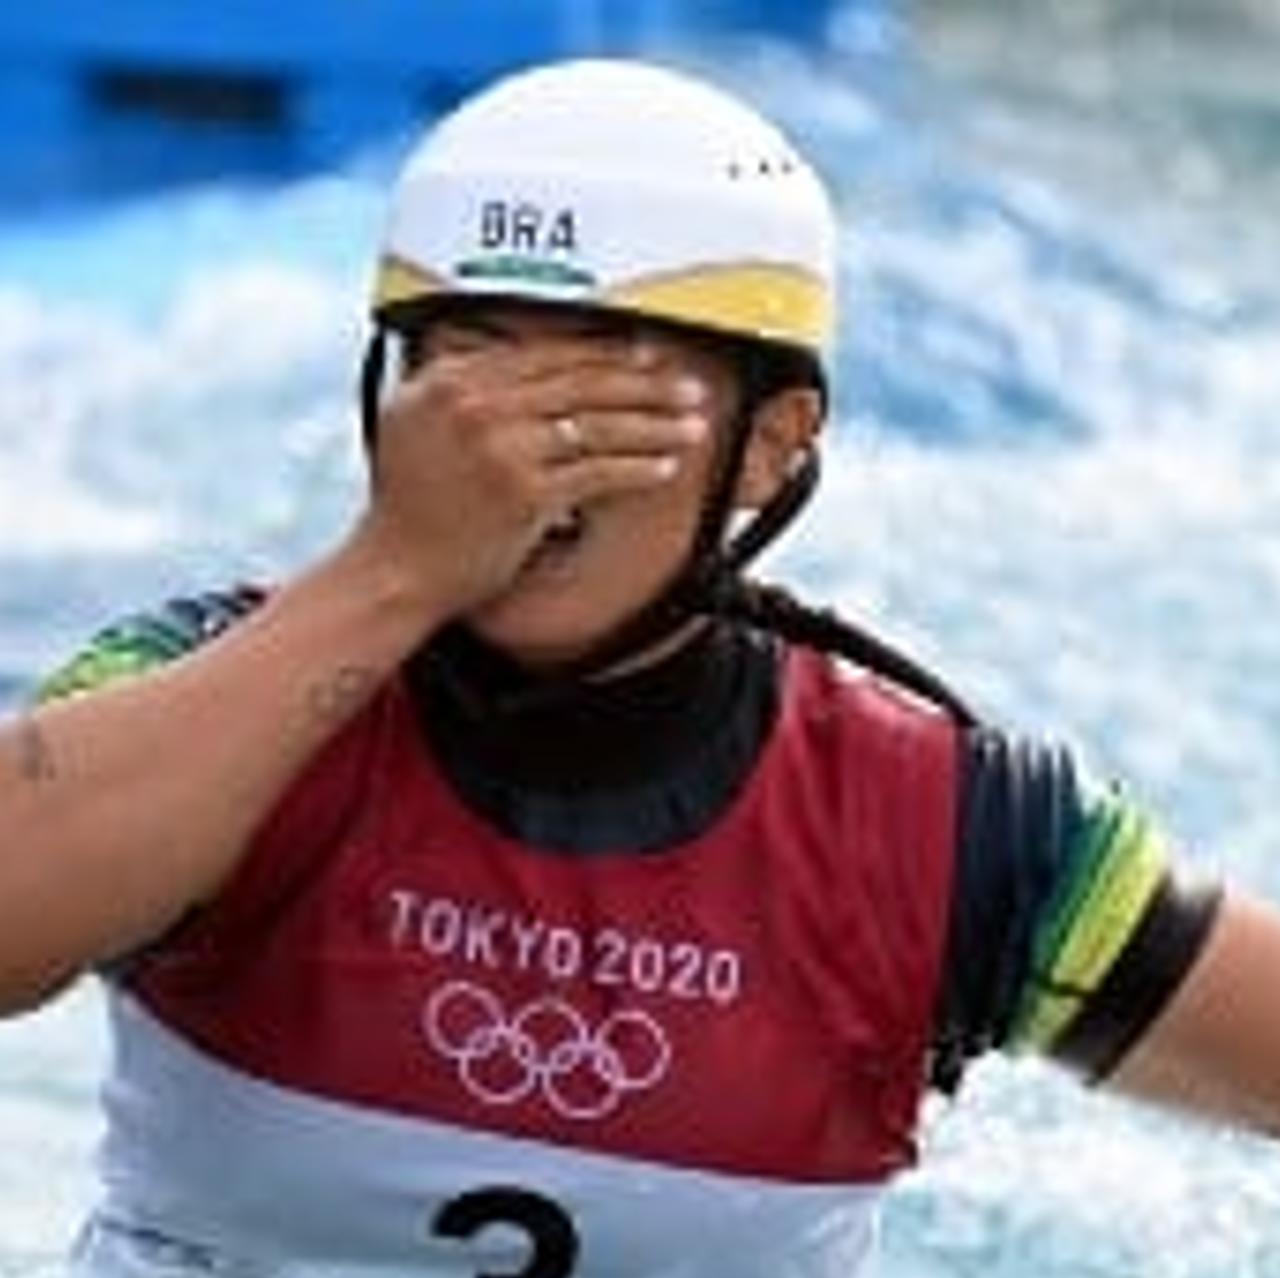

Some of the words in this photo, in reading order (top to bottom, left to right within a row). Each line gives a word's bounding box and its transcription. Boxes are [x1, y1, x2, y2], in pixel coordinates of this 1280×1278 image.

[480, 201, 577, 250] BRA
[389, 889, 582, 979] TOKYO
[593, 928, 741, 1005] 2020
